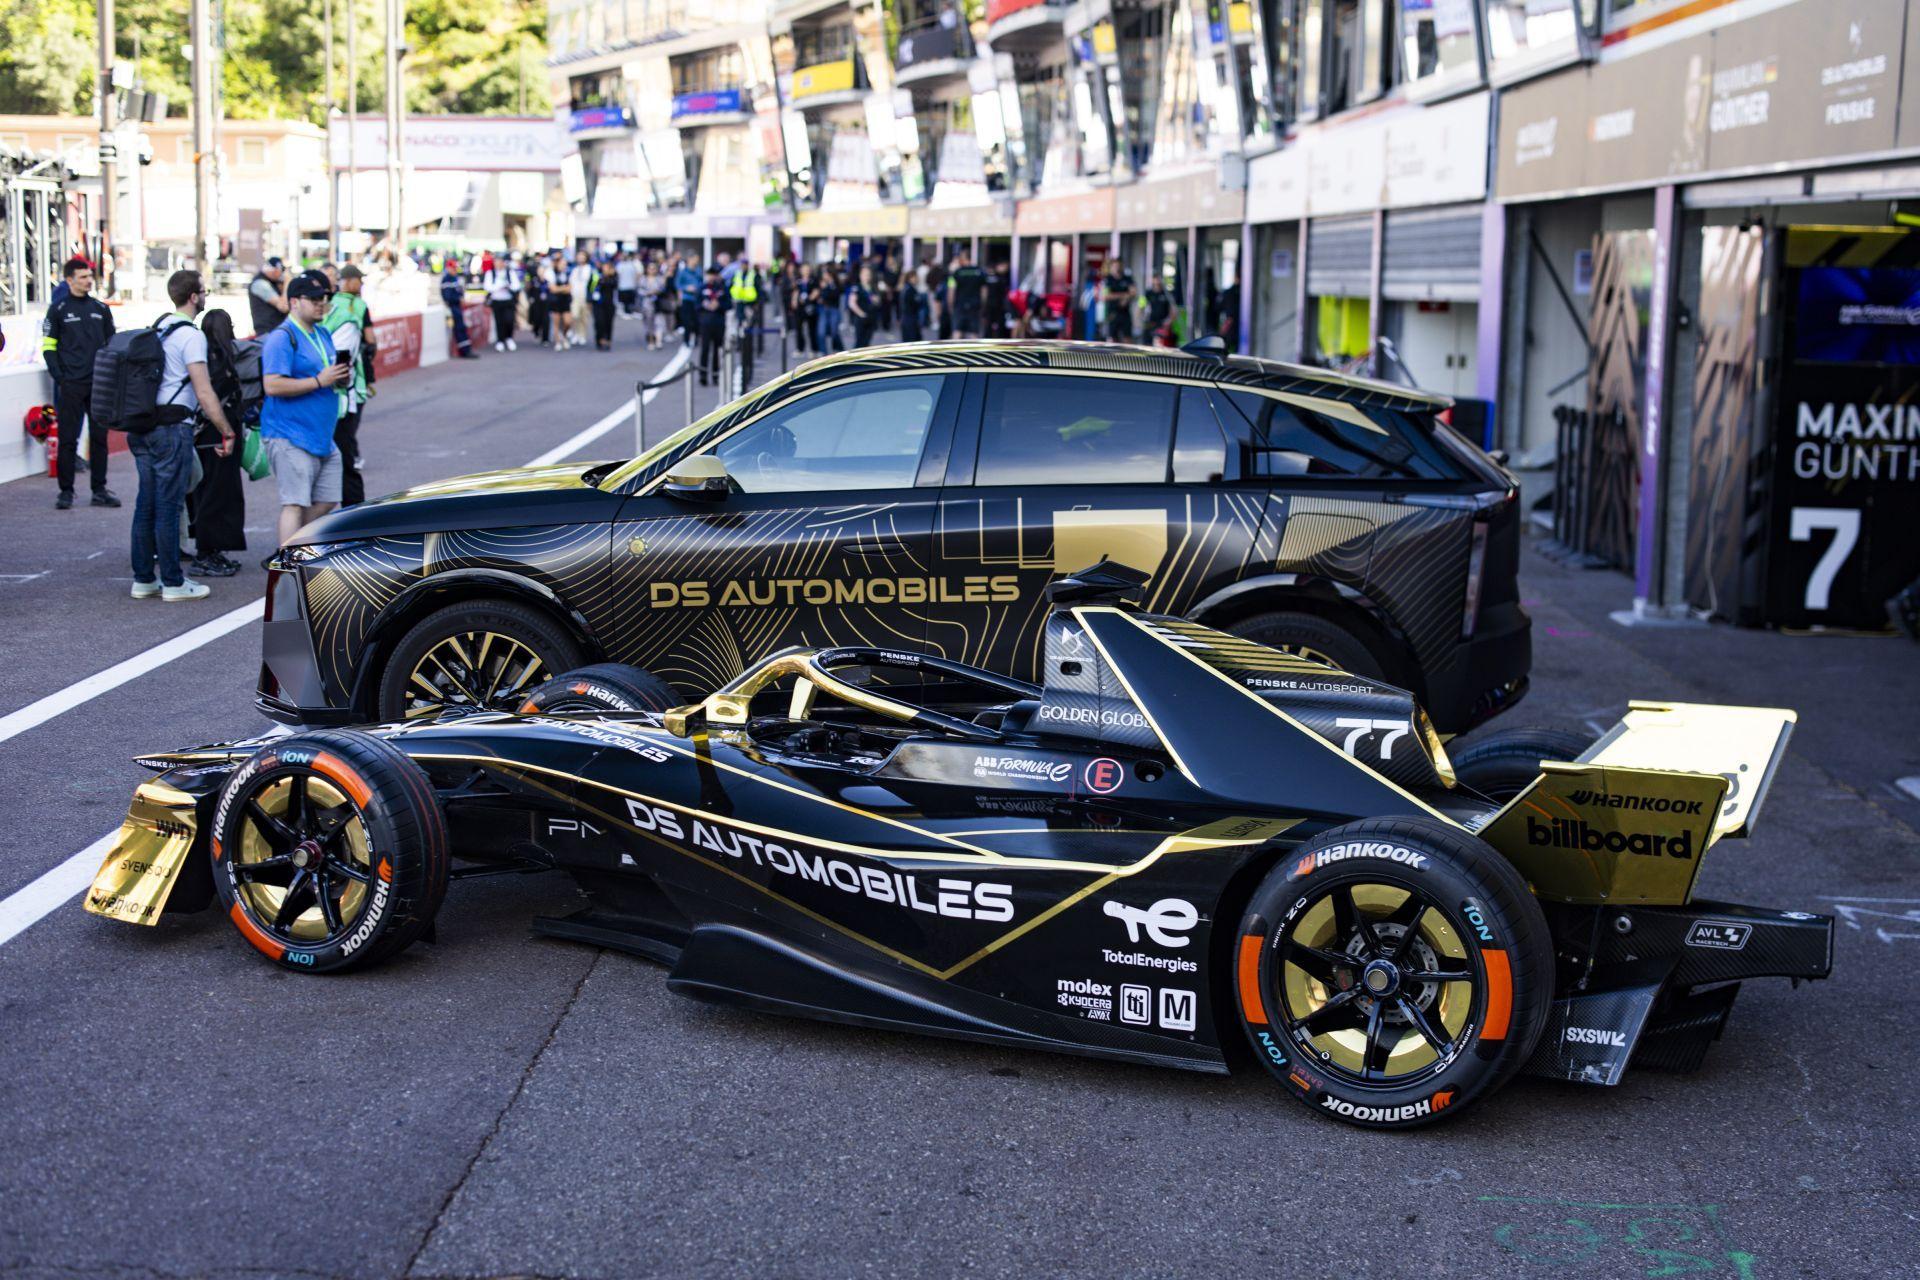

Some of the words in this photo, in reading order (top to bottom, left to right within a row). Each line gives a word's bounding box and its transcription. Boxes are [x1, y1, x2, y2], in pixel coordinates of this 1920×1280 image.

[1791, 507, 1861, 610] 7
[650, 581, 711, 608] DS
[718, 575, 1019, 606] AUTOMOBILES
[880, 651, 920, 661] PENSKE
[1246, 678, 1298, 689] PENSKE
[1299, 682, 1373, 694] AUTOSPORT
[1040, 705, 1099, 723] GOLDEN
[551, 720, 674, 763] AUTOMOBILES
[1335, 717, 1410, 760] 77
[974, 756, 997, 768] ABB
[997, 757, 1051, 775] FORMULA
[1094, 762, 1114, 788] E
[1527, 815, 1692, 860] billboard
[625, 798, 685, 840] DS
[692, 820, 1015, 922] AUTOMOBILES
[1695, 939, 1729, 947] RACETECH
[1696, 927, 1722, 940] AVL
[1102, 949, 1198, 973] TotalEnergies
[1057, 979, 1113, 996] molex
[1165, 993, 1191, 1021] M
[1566, 1027, 1612, 1045] SXSW
